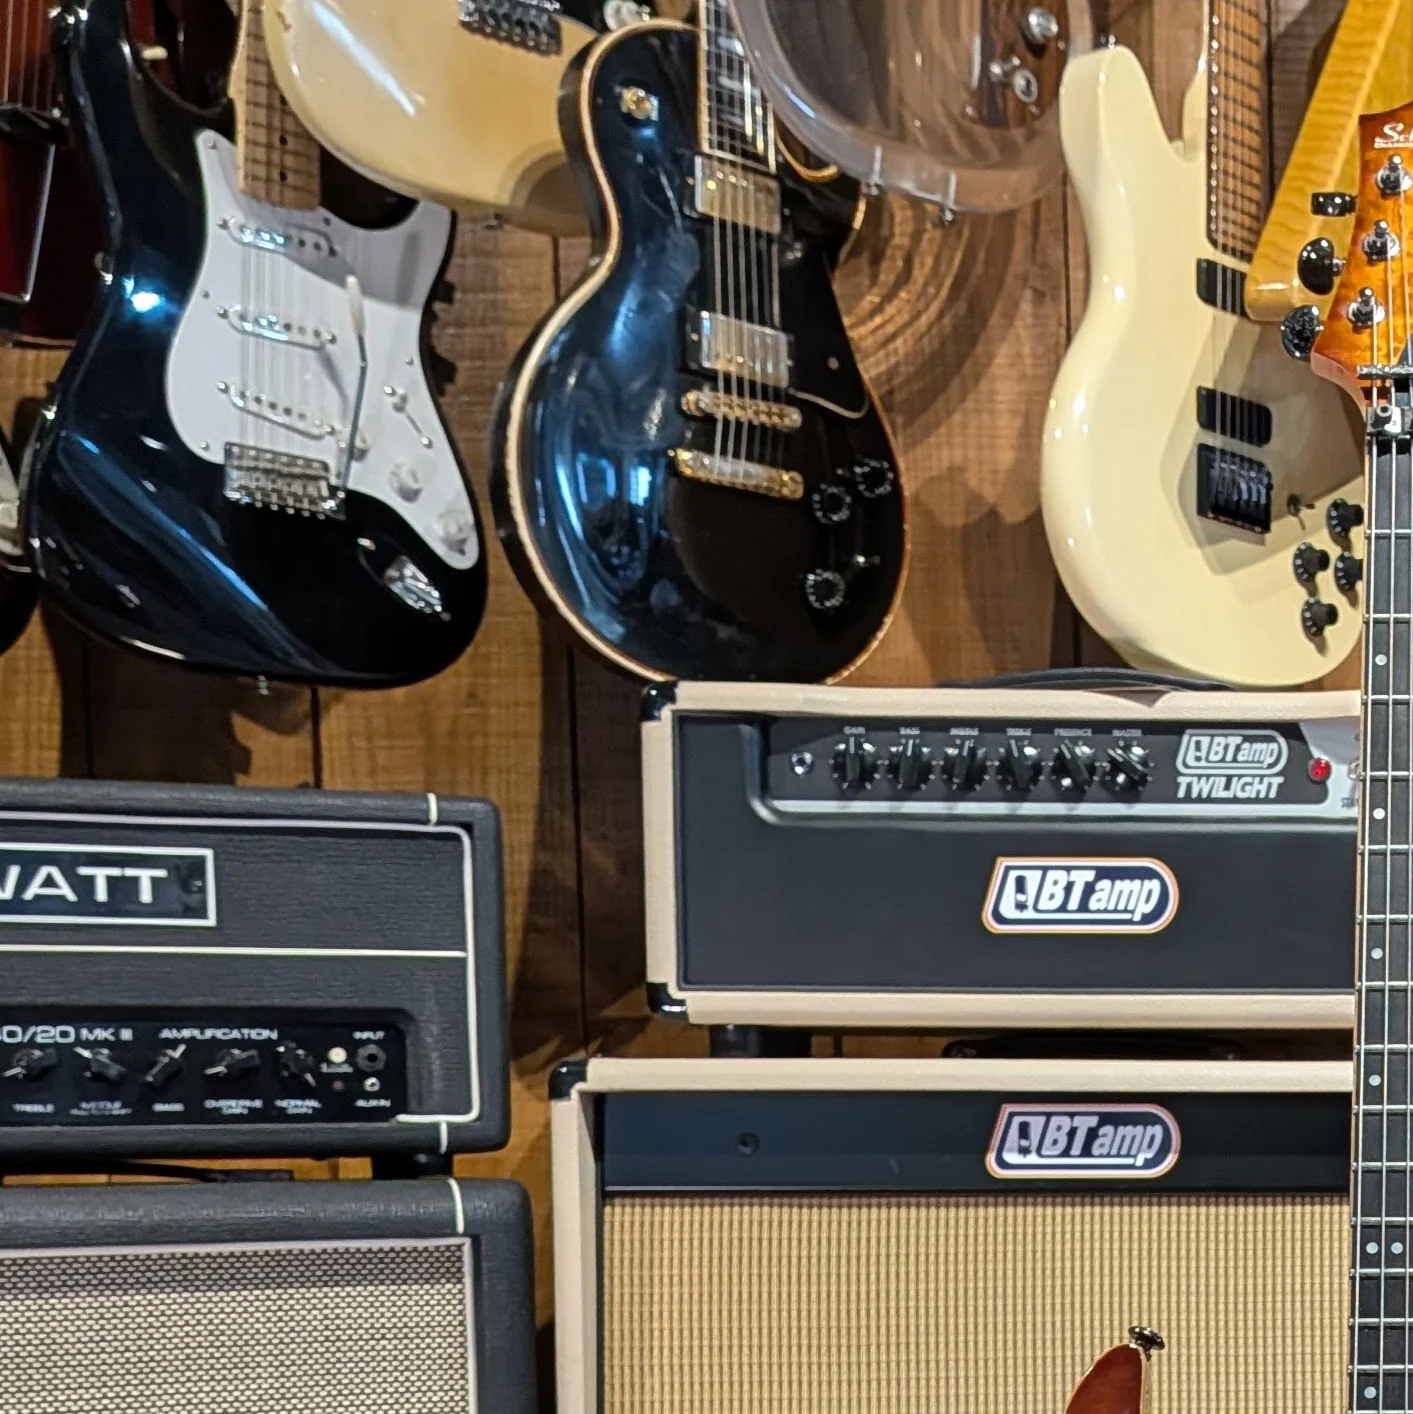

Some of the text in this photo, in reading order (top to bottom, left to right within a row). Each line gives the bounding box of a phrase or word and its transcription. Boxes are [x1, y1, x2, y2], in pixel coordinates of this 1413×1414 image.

[1176, 776, 1285, 799] TWILIGHT
[0, 864, 168, 903] ATT
[0, 1025, 76, 1044] 0/20
[80, 1027, 116, 1042] MK
